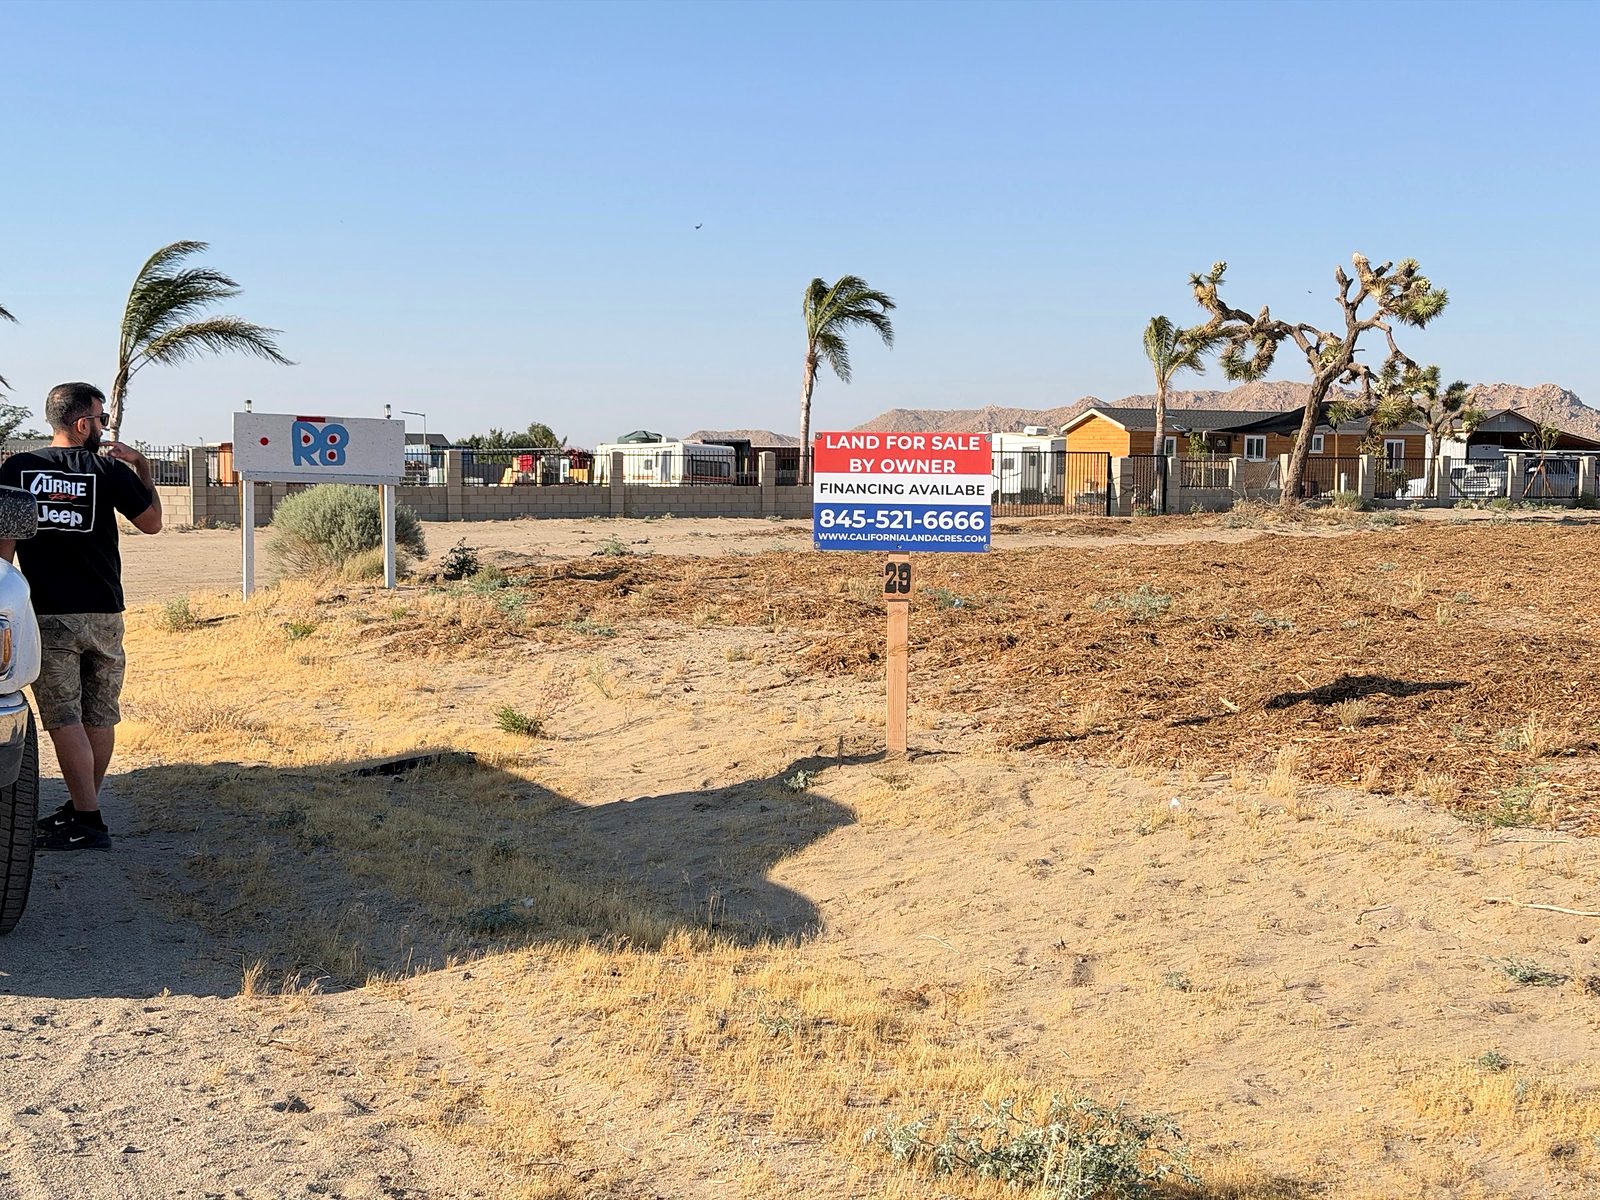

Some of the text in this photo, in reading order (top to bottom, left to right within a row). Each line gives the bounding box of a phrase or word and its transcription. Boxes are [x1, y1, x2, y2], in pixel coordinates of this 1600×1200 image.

[291, 421, 349, 466] R8
[826, 435, 980, 451] LAND FOR SALE
[849, 458, 956, 473] BY OWNER
[820, 483, 985, 496] FINANCING AVAILABE
[37, 505, 83, 527] Jeep
[819, 509, 985, 530] 845-521-6666
[818, 532, 987, 543] WWW.CALIFORNIALANDACRES.COM
[884, 562, 912, 594] 29
